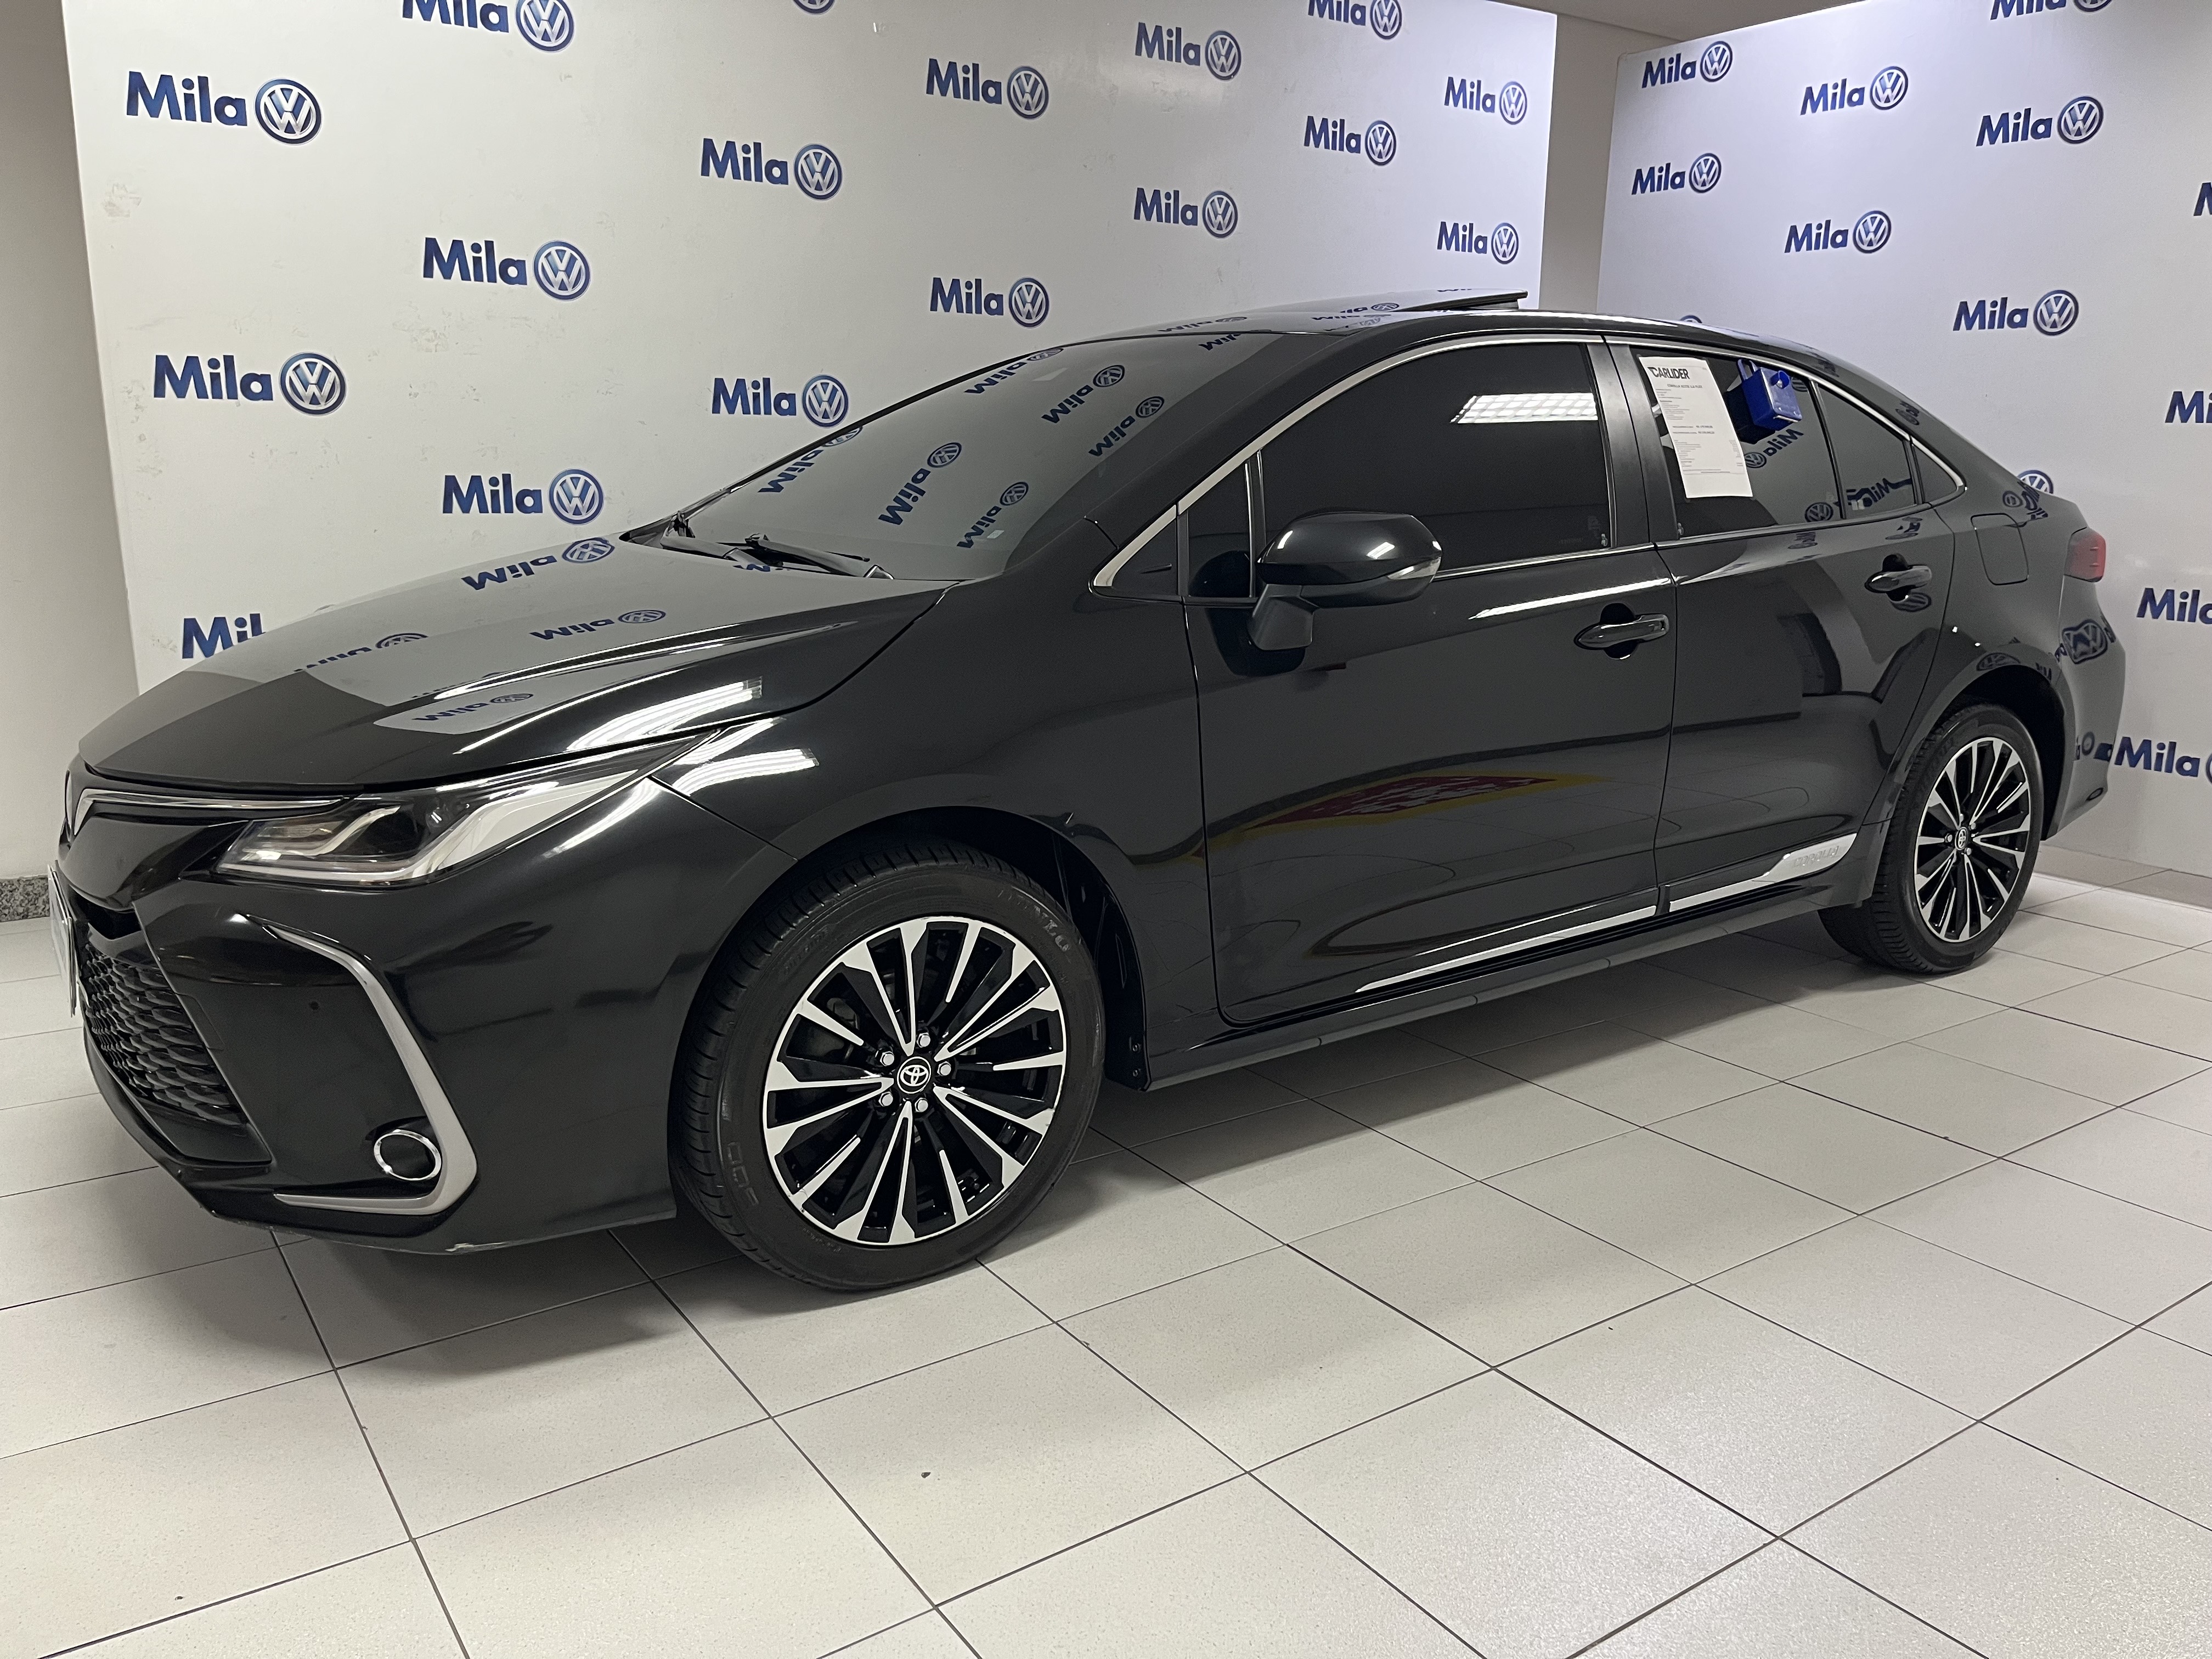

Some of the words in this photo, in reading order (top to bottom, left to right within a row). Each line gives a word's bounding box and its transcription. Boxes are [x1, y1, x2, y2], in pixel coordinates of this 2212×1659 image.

[1135, 22, 1200, 66] Mila
[926, 58, 1002, 104] Mila
[1642, 53, 1696, 88] Mila
[127, 71, 247, 126] Mila
[1444, 77, 1495, 112] Mila
[1801, 81, 1865, 115] Mila
[1304, 116, 1361, 154] Mila
[1976, 108, 2052, 146] Mila
[701, 138, 788, 185] Mila
[1632, 162, 1685, 195] Mila
[1134, 188, 1198, 225] Mila
[1437, 222, 1487, 254] Mila
[1785, 219, 1848, 253] Mila
[424, 238, 527, 285] Mila
[930, 278, 1003, 315] Mila
[1953, 297, 2029, 331] Mila
[154, 355, 273, 401] Mila
[1647, 367, 1690, 380] CARLIDER
[712, 377, 796, 416] Mila
[443, 473, 543, 514] Mila
[2114, 737, 2200, 777] Mila
